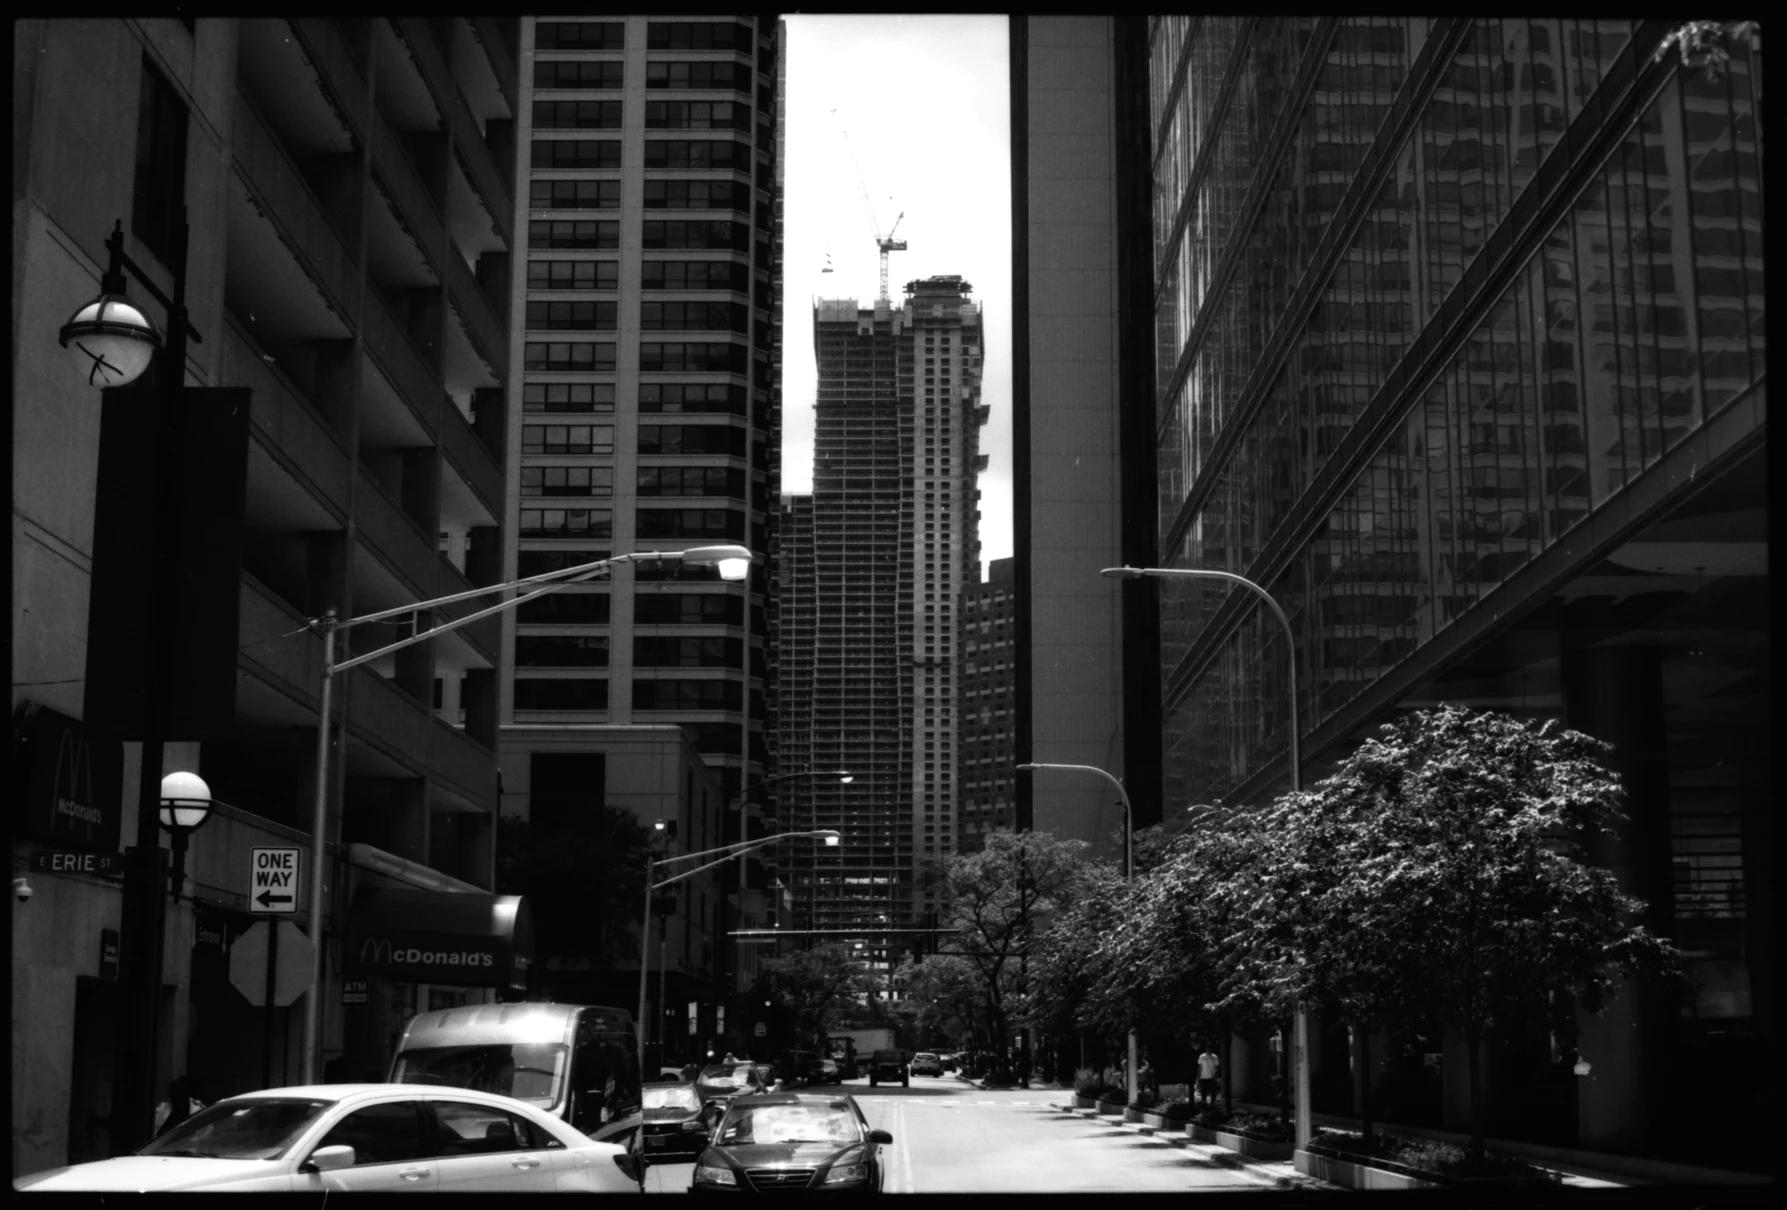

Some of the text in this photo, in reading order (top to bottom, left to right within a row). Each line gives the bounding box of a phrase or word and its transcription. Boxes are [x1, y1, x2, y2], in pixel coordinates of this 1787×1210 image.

[57, 795, 103, 824] McDonald's
[39, 854, 112, 871] E ERIE ST
[258, 853, 293, 868] ONE
[257, 871, 293, 887] WAY
[360, 937, 494, 967] McDonald's
[344, 981, 367, 992] ATM
